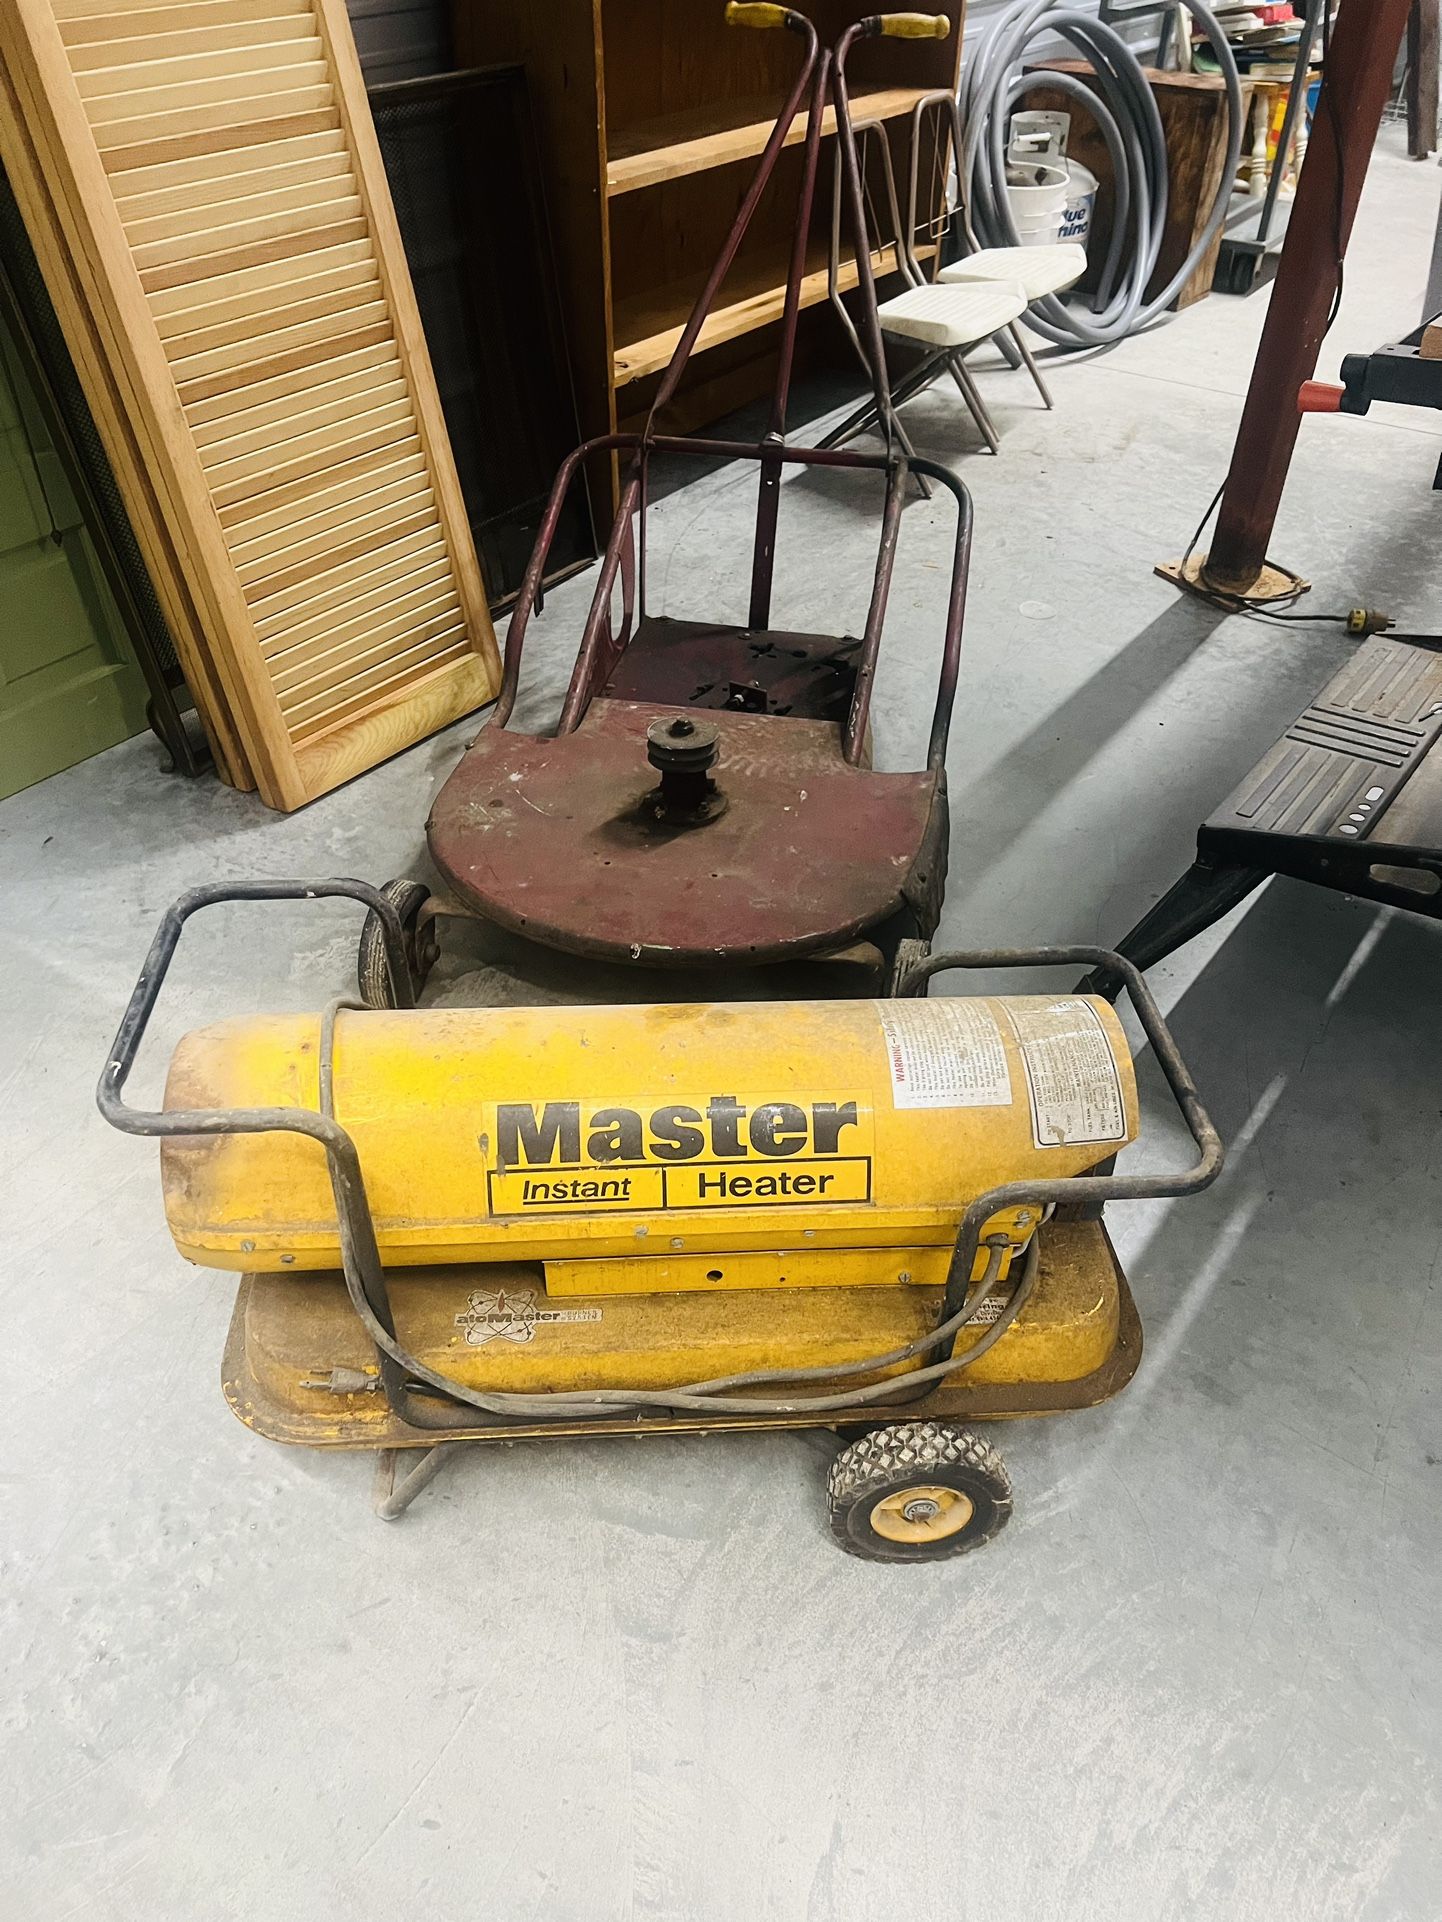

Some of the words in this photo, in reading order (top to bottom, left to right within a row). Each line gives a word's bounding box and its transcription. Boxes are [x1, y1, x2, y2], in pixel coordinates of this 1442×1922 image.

[895, 1044, 906, 1082] WARNING
[1032, 1073, 1043, 1106] OPERATION
[496, 1096, 857, 1164] Master
[523, 1178, 631, 1199] Instant
[698, 1171, 834, 1197] Heater
[456, 1312, 560, 1323] atoMaster
